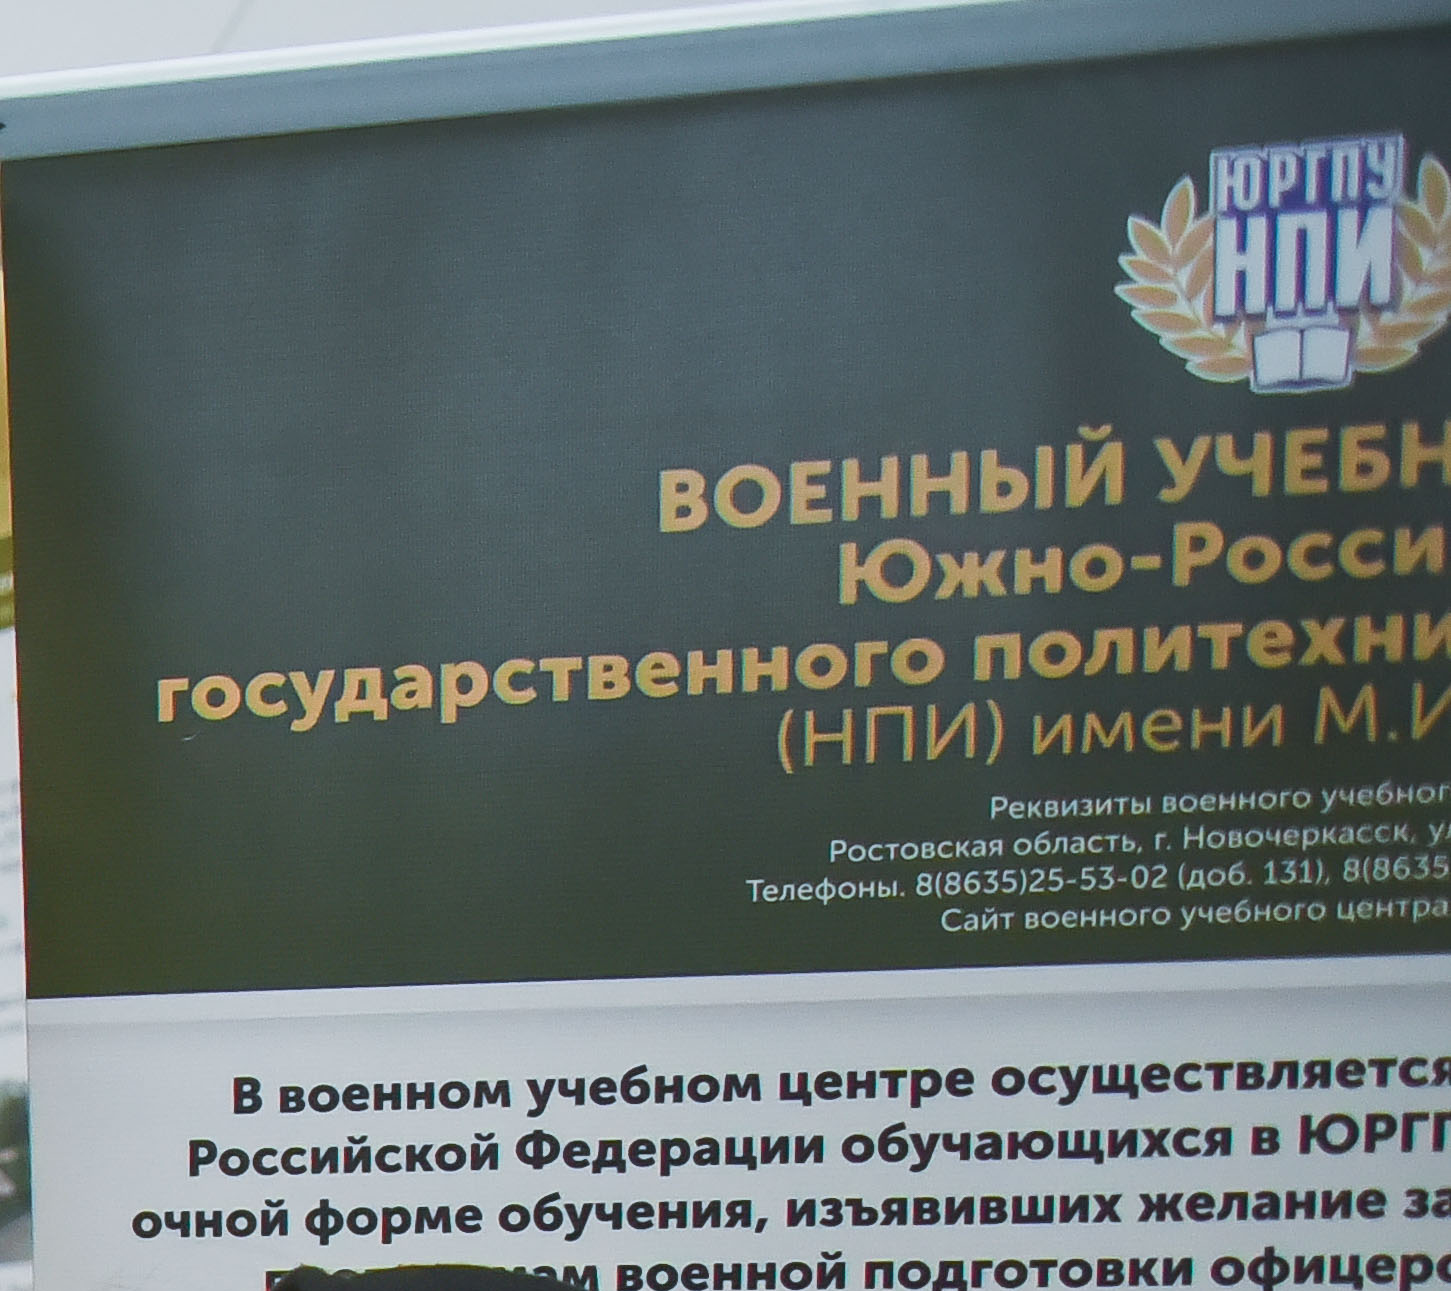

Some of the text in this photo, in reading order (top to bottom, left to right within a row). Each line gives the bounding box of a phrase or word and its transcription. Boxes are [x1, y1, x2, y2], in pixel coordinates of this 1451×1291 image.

[1216, 138, 1398, 214] ЮРГПУ
[1214, 206, 1396, 317] НПИ
[658, 425, 1125, 533] ВОЕННЫЙ
[157, 637, 945, 731] государственного
[777, 699, 1004, 774] (НПИ)
[1032, 703, 1285, 756] имени
[990, 795, 1151, 820] Реквизиты
[1162, 789, 1312, 815] военного
[829, 838, 1003, 863] Ростовская
[1013, 830, 1143, 857] область,
[1154, 833, 1171, 851] г.
[1184, 823, 1416, 851] Новочеркасск,
[746, 854, 1449, 905] Телефоны. 8(8635)25-53-02 (доб. 131), 8(8635
[941, 898, 1449, 932] Сайт военного учебного центра
[232, 1076, 262, 1114] В
[279, 1077, 511, 1114] военном
[526, 1063, 762, 1117] учебном
[779, 1067, 974, 1108] центре
[188, 1134, 500, 1178] Российской
[515, 1129, 826, 1177] Федерации
[841, 1122, 1233, 1172] обучающихся
[1251, 1124, 1281, 1155] в
[131, 1200, 289, 1239] очной
[304, 1198, 483, 1246] форме
[498, 1191, 768, 1243] обучения,
[786, 1190, 1123, 1229] изъявивших
[1137, 1185, 1387, 1223] желание
